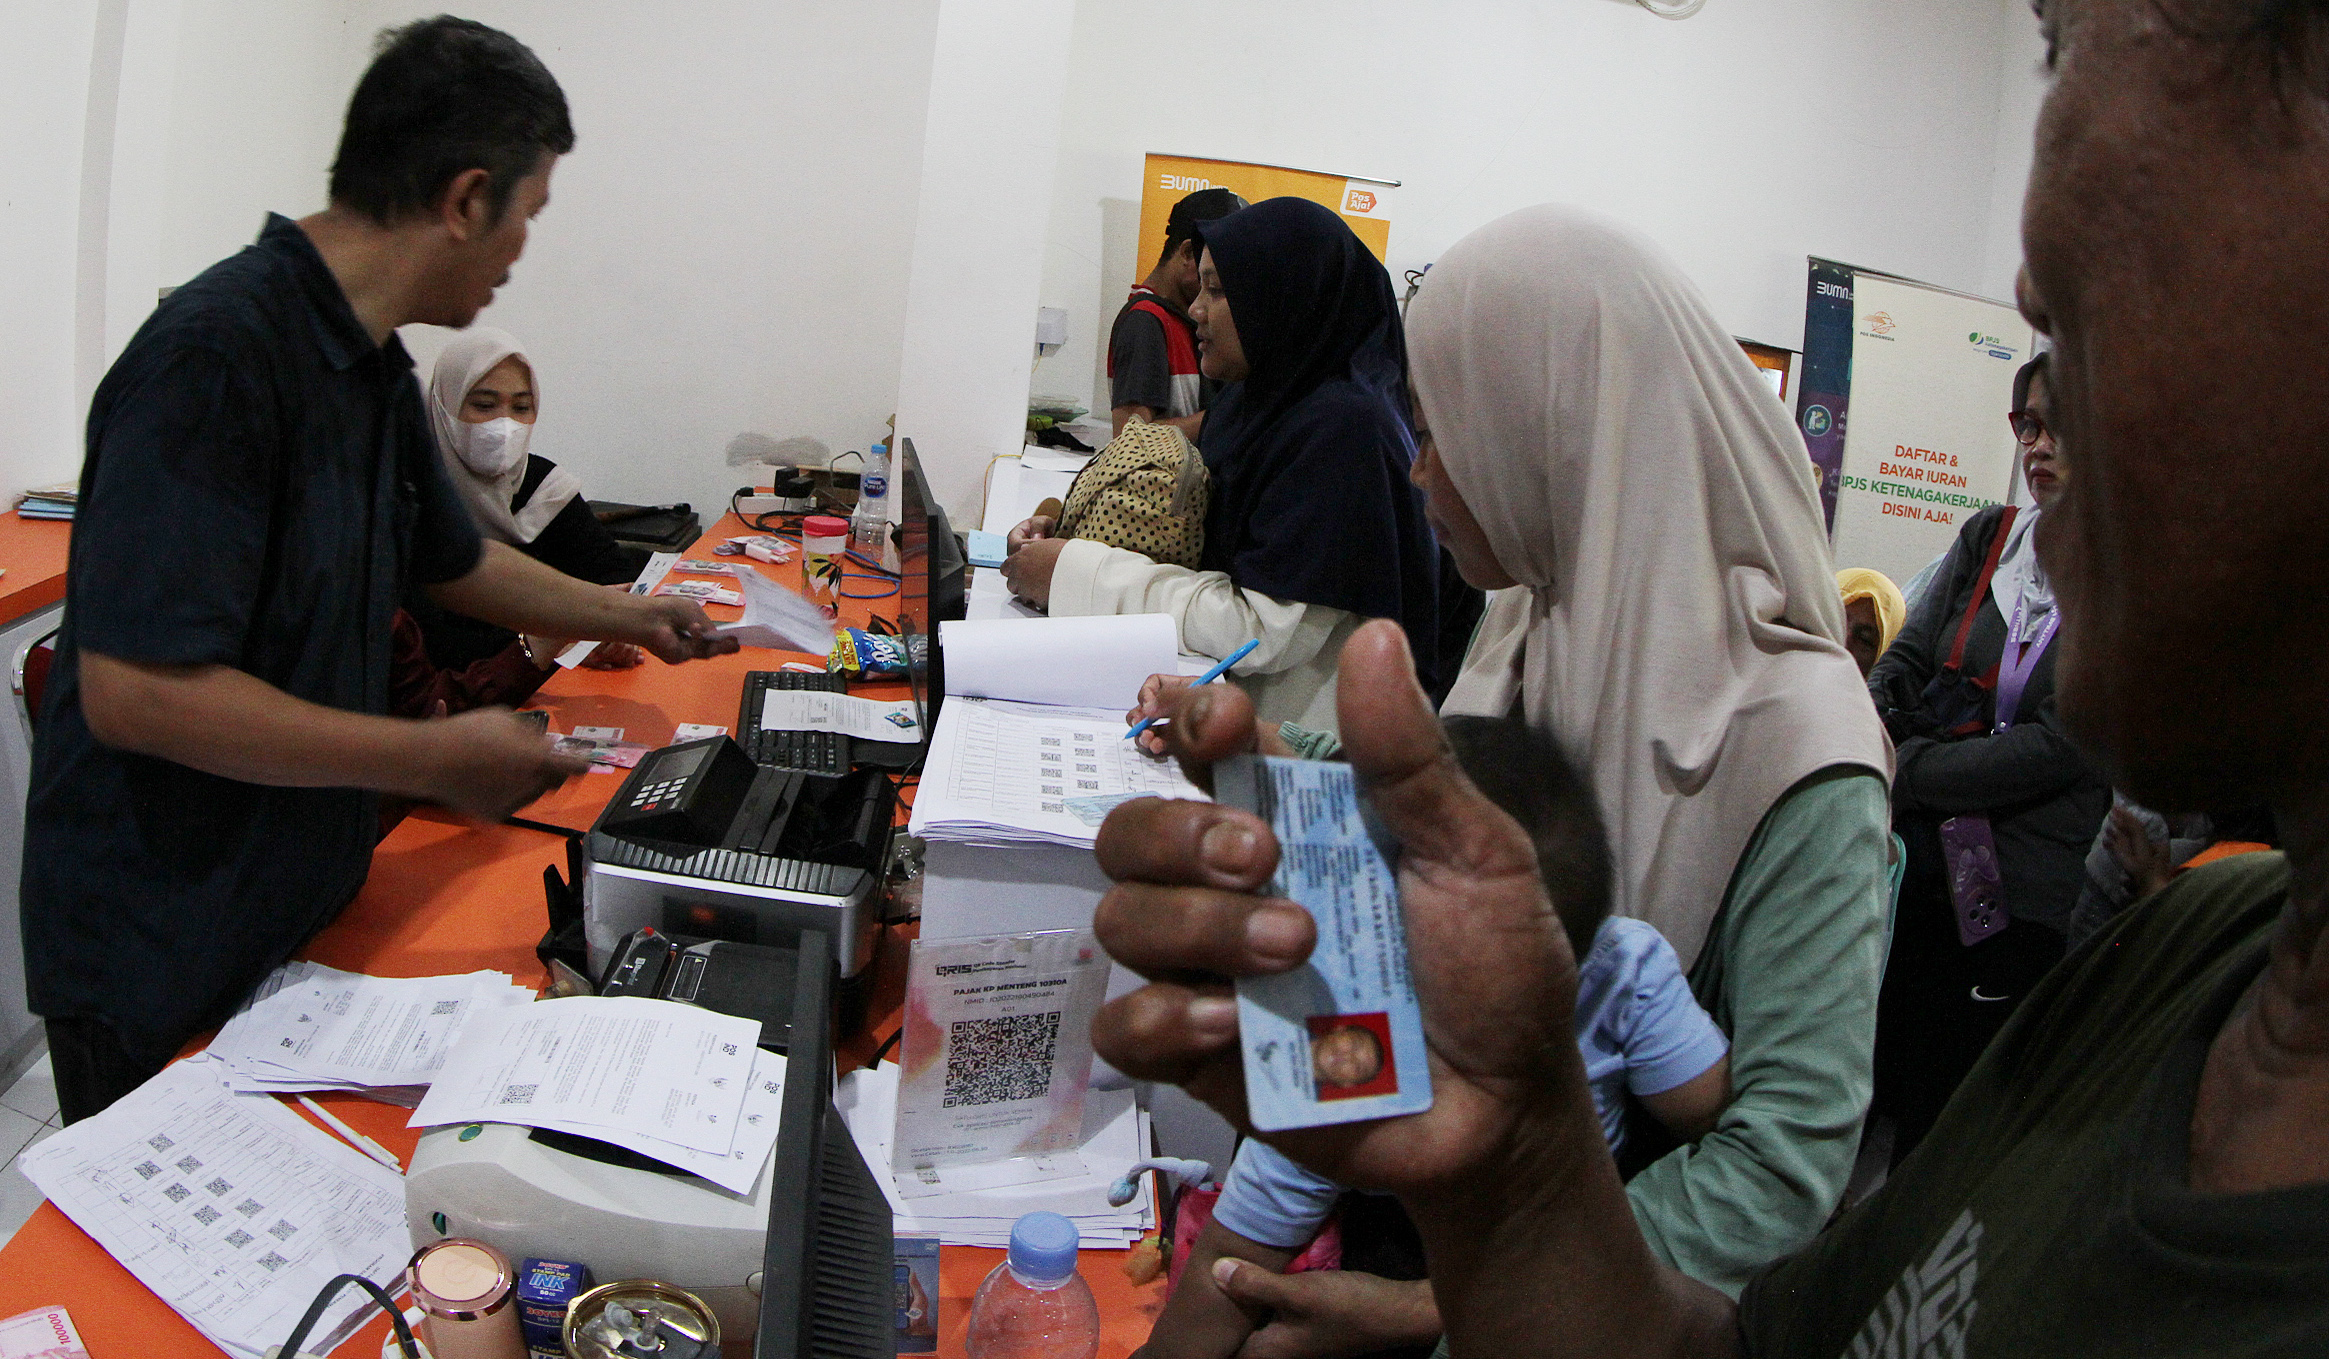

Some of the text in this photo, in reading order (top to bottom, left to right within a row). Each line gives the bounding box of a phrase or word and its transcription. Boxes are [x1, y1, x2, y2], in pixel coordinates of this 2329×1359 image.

[1160, 174, 1210, 192] BUMN
[1350, 200, 1371, 210] Aja!
[1351, 191, 1370, 202] Pos
[1816, 281, 1849, 300] BUMN
[1895, 445, 1958, 467] DAFTAR &
[1879, 462, 1967, 488] BAYAR IURAN
[1871, 480, 2002, 511] KETENAGAKERJAA
[1882, 502, 1953, 525] DISINI AJA!
[936, 964, 972, 977] QRIS
[954, 987, 982, 995] PAJAK
[996, 981, 1038, 992] MENTENG
[529, 1273, 571, 1290] INK
[47, 1313, 72, 1345] 100000
